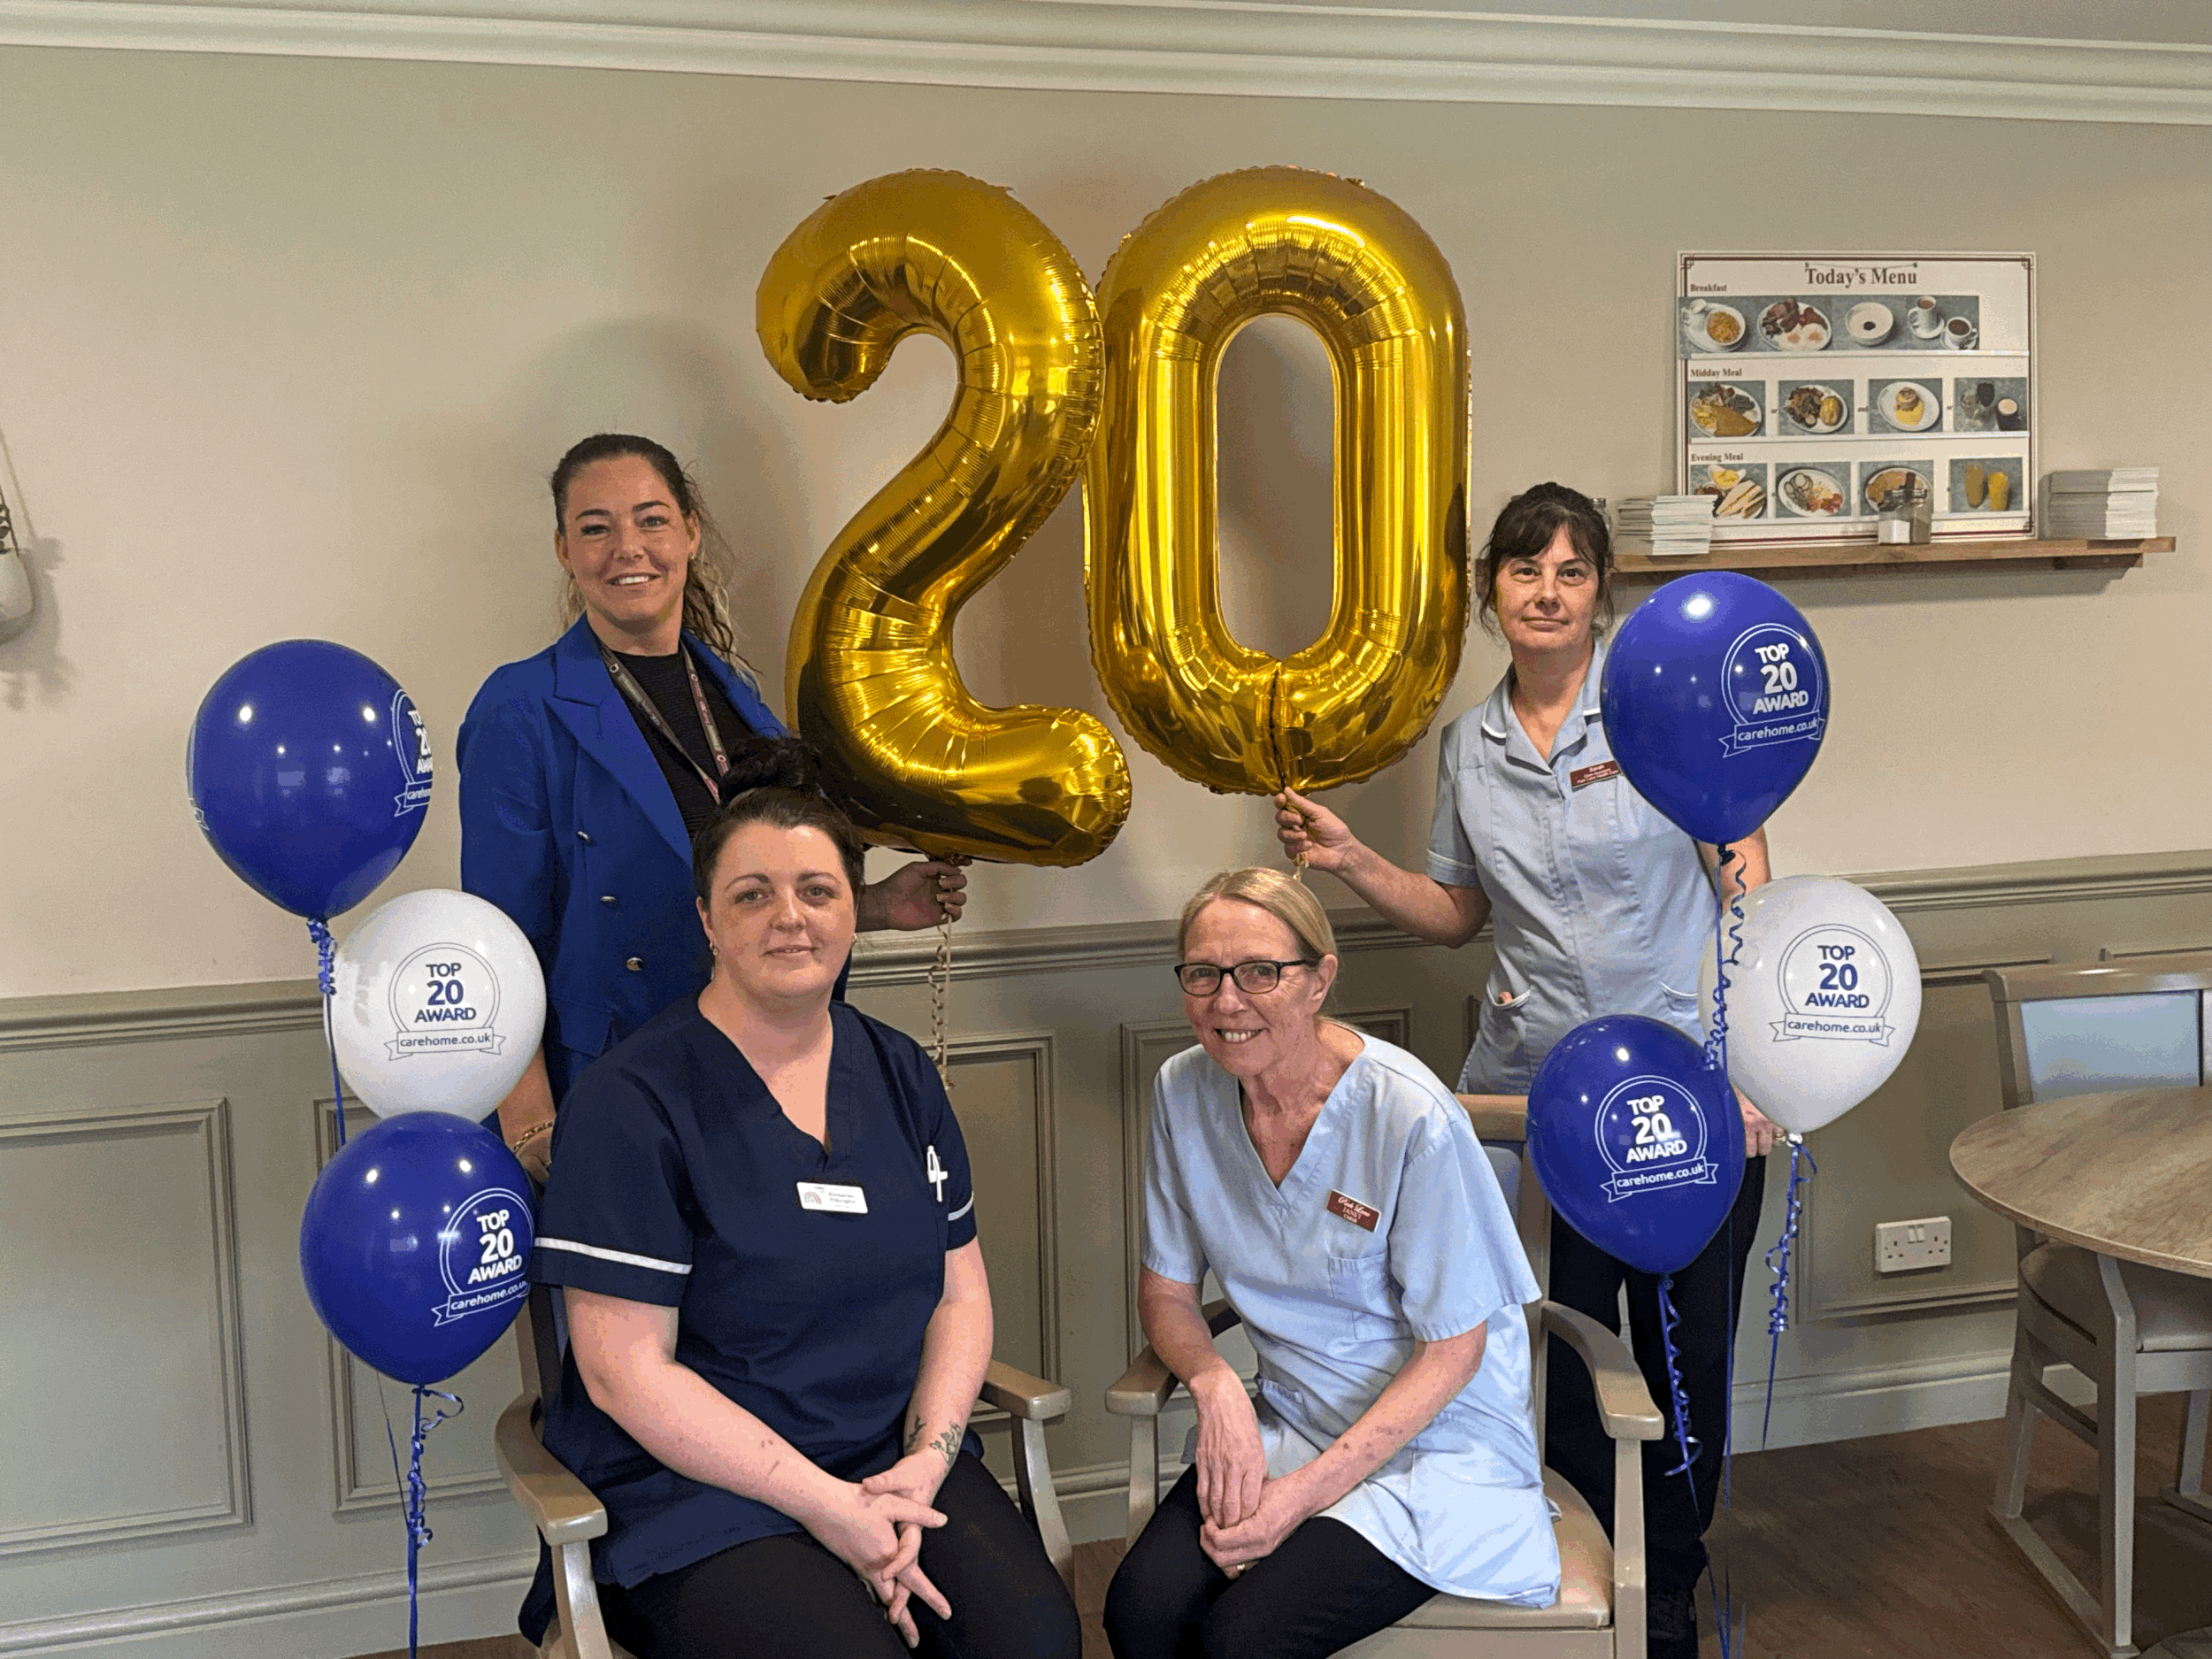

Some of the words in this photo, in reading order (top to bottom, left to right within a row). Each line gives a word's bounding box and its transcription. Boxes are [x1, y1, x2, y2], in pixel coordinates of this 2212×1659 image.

[1690, 283, 1727, 293] Breakfast
[1805, 268, 1866, 289] Today's
[1871, 268, 1917, 285] Menu
[1691, 368, 1720, 380] Midday
[1723, 367, 1742, 377] Meal
[1691, 452, 1722, 463] Evening
[1724, 452, 1744, 461] Meal
[757, 166, 1471, 867] 20
[1754, 642, 1790, 664] TOP
[1760, 661, 1798, 695] 20
[1752, 690, 1809, 715] AWARD
[1737, 718, 1817, 741] carehome.co.uk
[1816, 944, 1856, 961] TOP
[426, 962, 462, 978] TOP
[1818, 963, 1858, 991] 20
[426, 979, 465, 1006] 20
[1804, 992, 1870, 1009] AWARD
[413, 1007, 477, 1024] AWARD
[1787, 1020, 1882, 1033] carehome.co.uk
[400, 1032, 491, 1048] carehome.co.uk
[1626, 1094, 1665, 1116] TOP
[1631, 1112, 1673, 1145] 20
[1625, 1140, 1688, 1164] AWARD
[1616, 1163, 1705, 1187] carehome.co.uk
[476, 1209, 510, 1233] TOP
[479, 1228, 514, 1264] 20
[467, 1254, 523, 1285] AWARD
